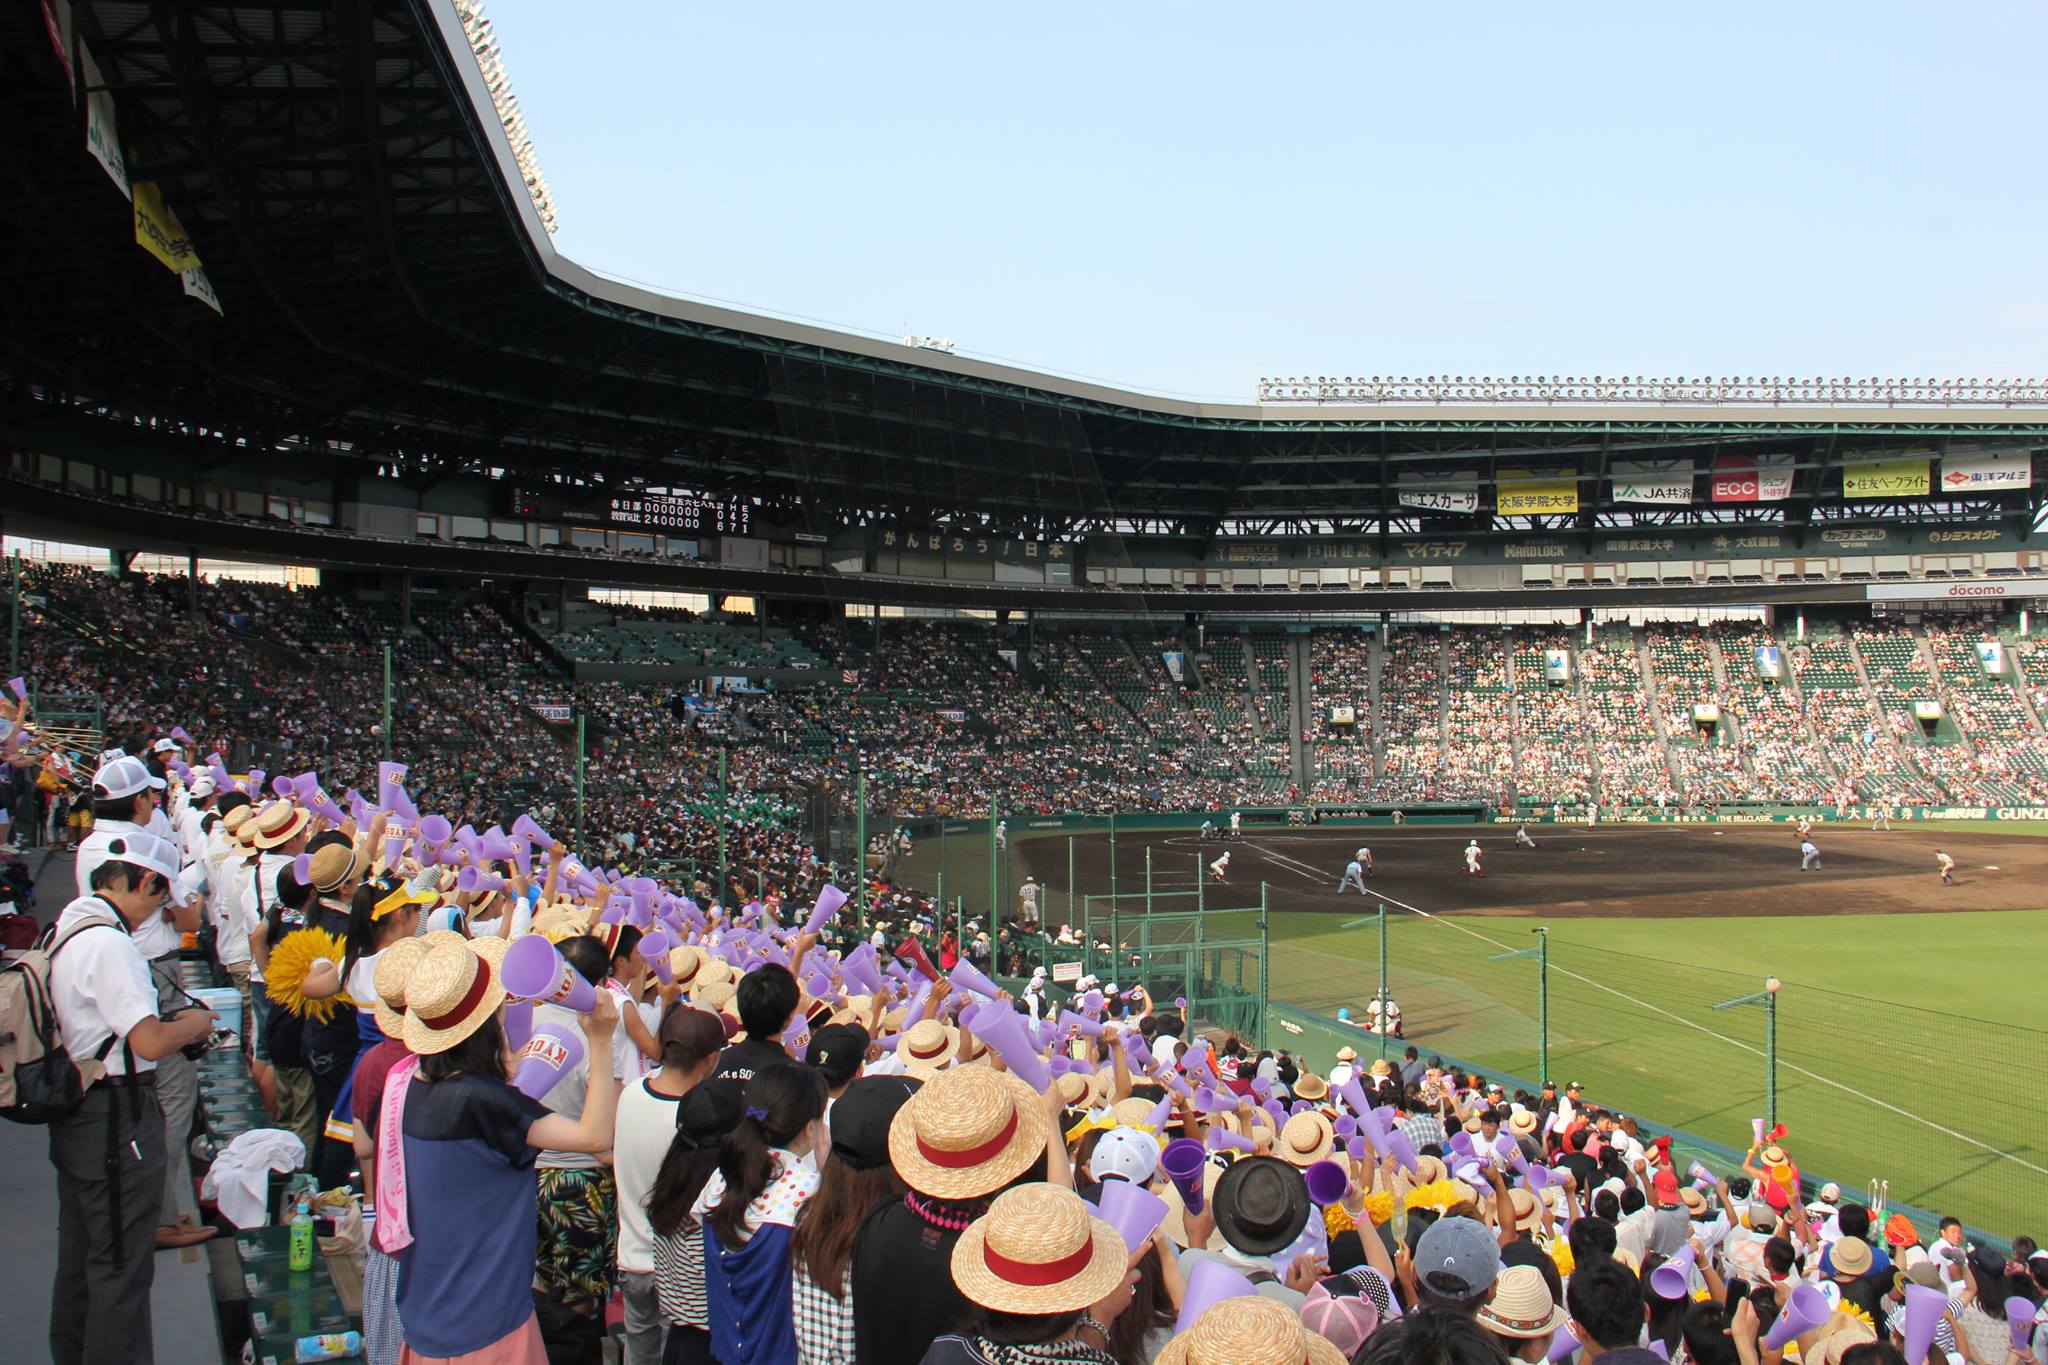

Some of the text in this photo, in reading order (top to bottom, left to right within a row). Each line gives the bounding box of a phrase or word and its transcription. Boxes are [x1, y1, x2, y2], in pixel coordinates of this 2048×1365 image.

[1857, 476, 1929, 490] 住友ベークライト
[1970, 471, 2027, 482] 東洋アルミ
[1643, 486, 1692, 500] JA共済
[1715, 481, 1755, 496] ECC
[1417, 493, 1476, 509] エスカーサ
[1499, 495, 1575, 509] 大阪学院大学
[730, 512, 736, 521] 4
[742, 513, 748, 522] 2
[717, 522, 724, 531] 6
[730, 523, 736, 532] 7
[743, 524, 748, 534] 1
[1941, 530, 2001, 543] シミズオクト
[1307, 544, 1371, 559] 戸田建設
[1402, 541, 1468, 558] マイティア
[1948, 584, 2005, 596] docomo
